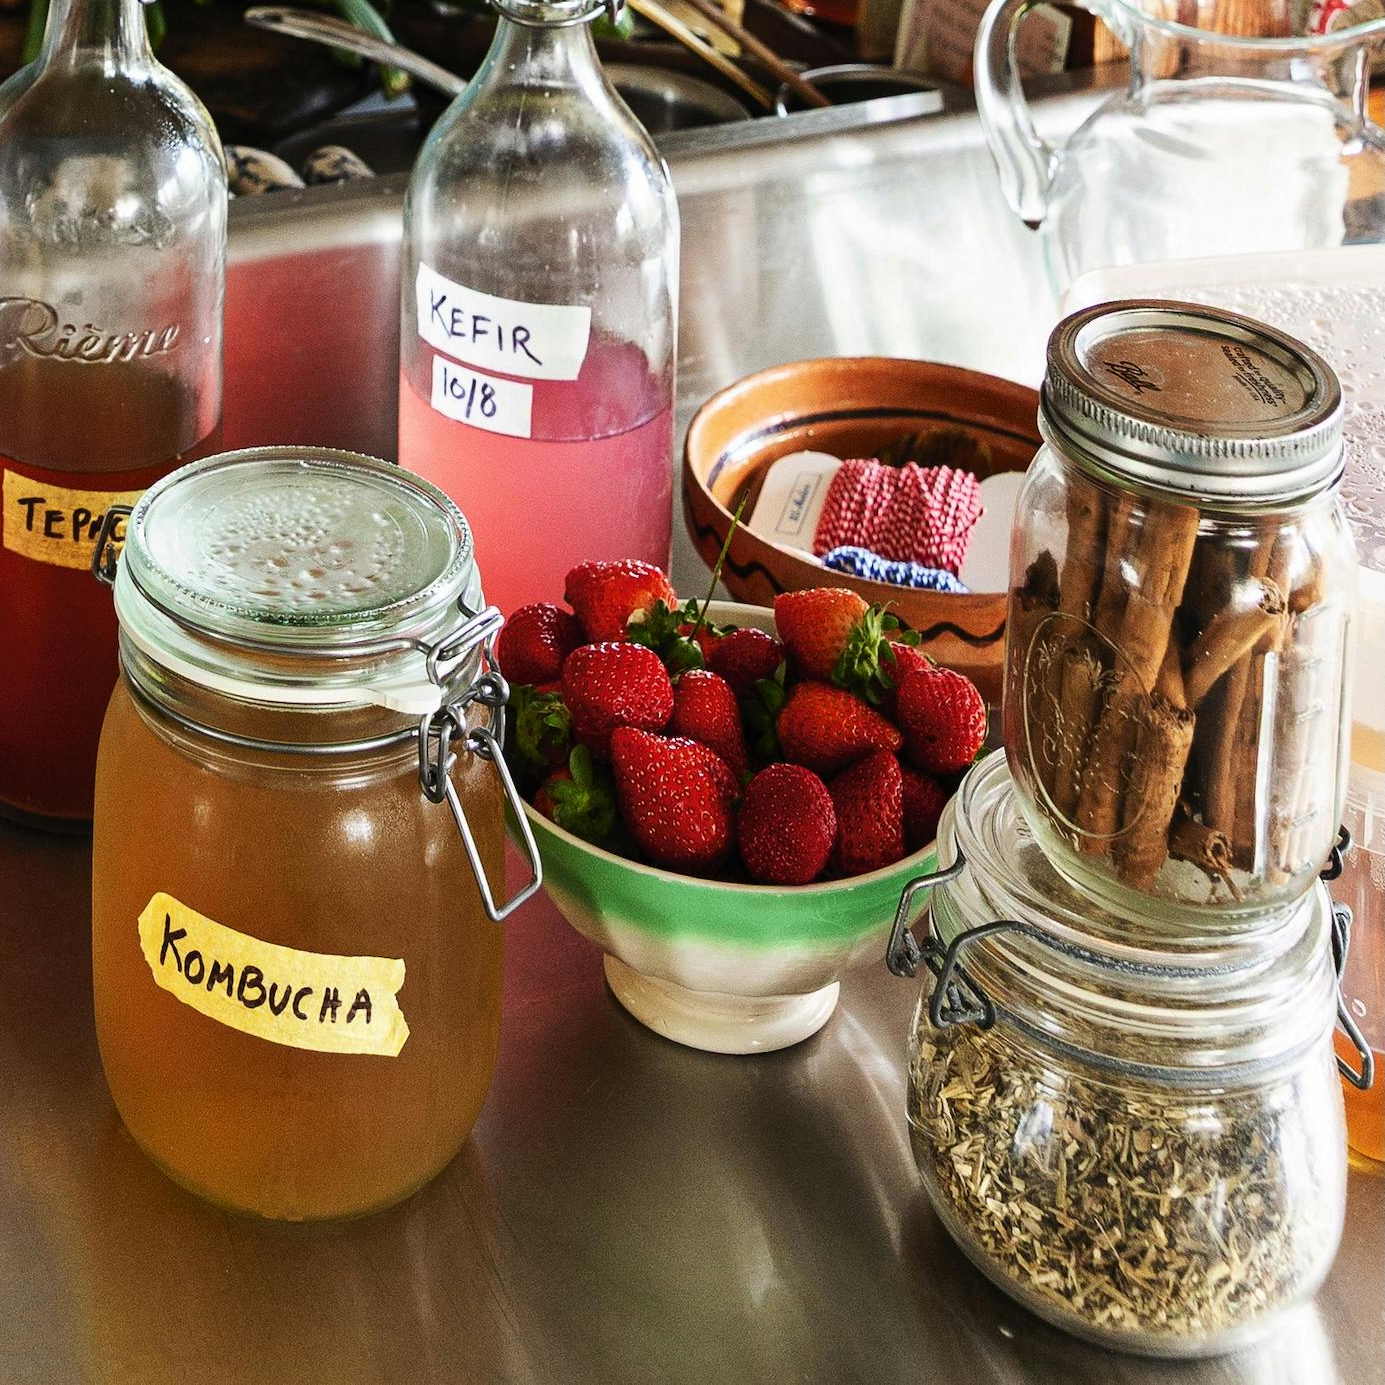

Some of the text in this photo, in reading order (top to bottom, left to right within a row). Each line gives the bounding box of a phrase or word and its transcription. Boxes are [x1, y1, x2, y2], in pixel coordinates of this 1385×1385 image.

[430, 288, 543, 366] KEFIR
[443, 367, 497, 419] 10/8
[1102, 360, 1162, 394] Ball
[1243, 372, 1276, 405] freshness
[1259, 376, 1285, 399] quality
[17, 496, 126, 543] TEPAC
[159, 912, 374, 1025] KOMBUCHA
